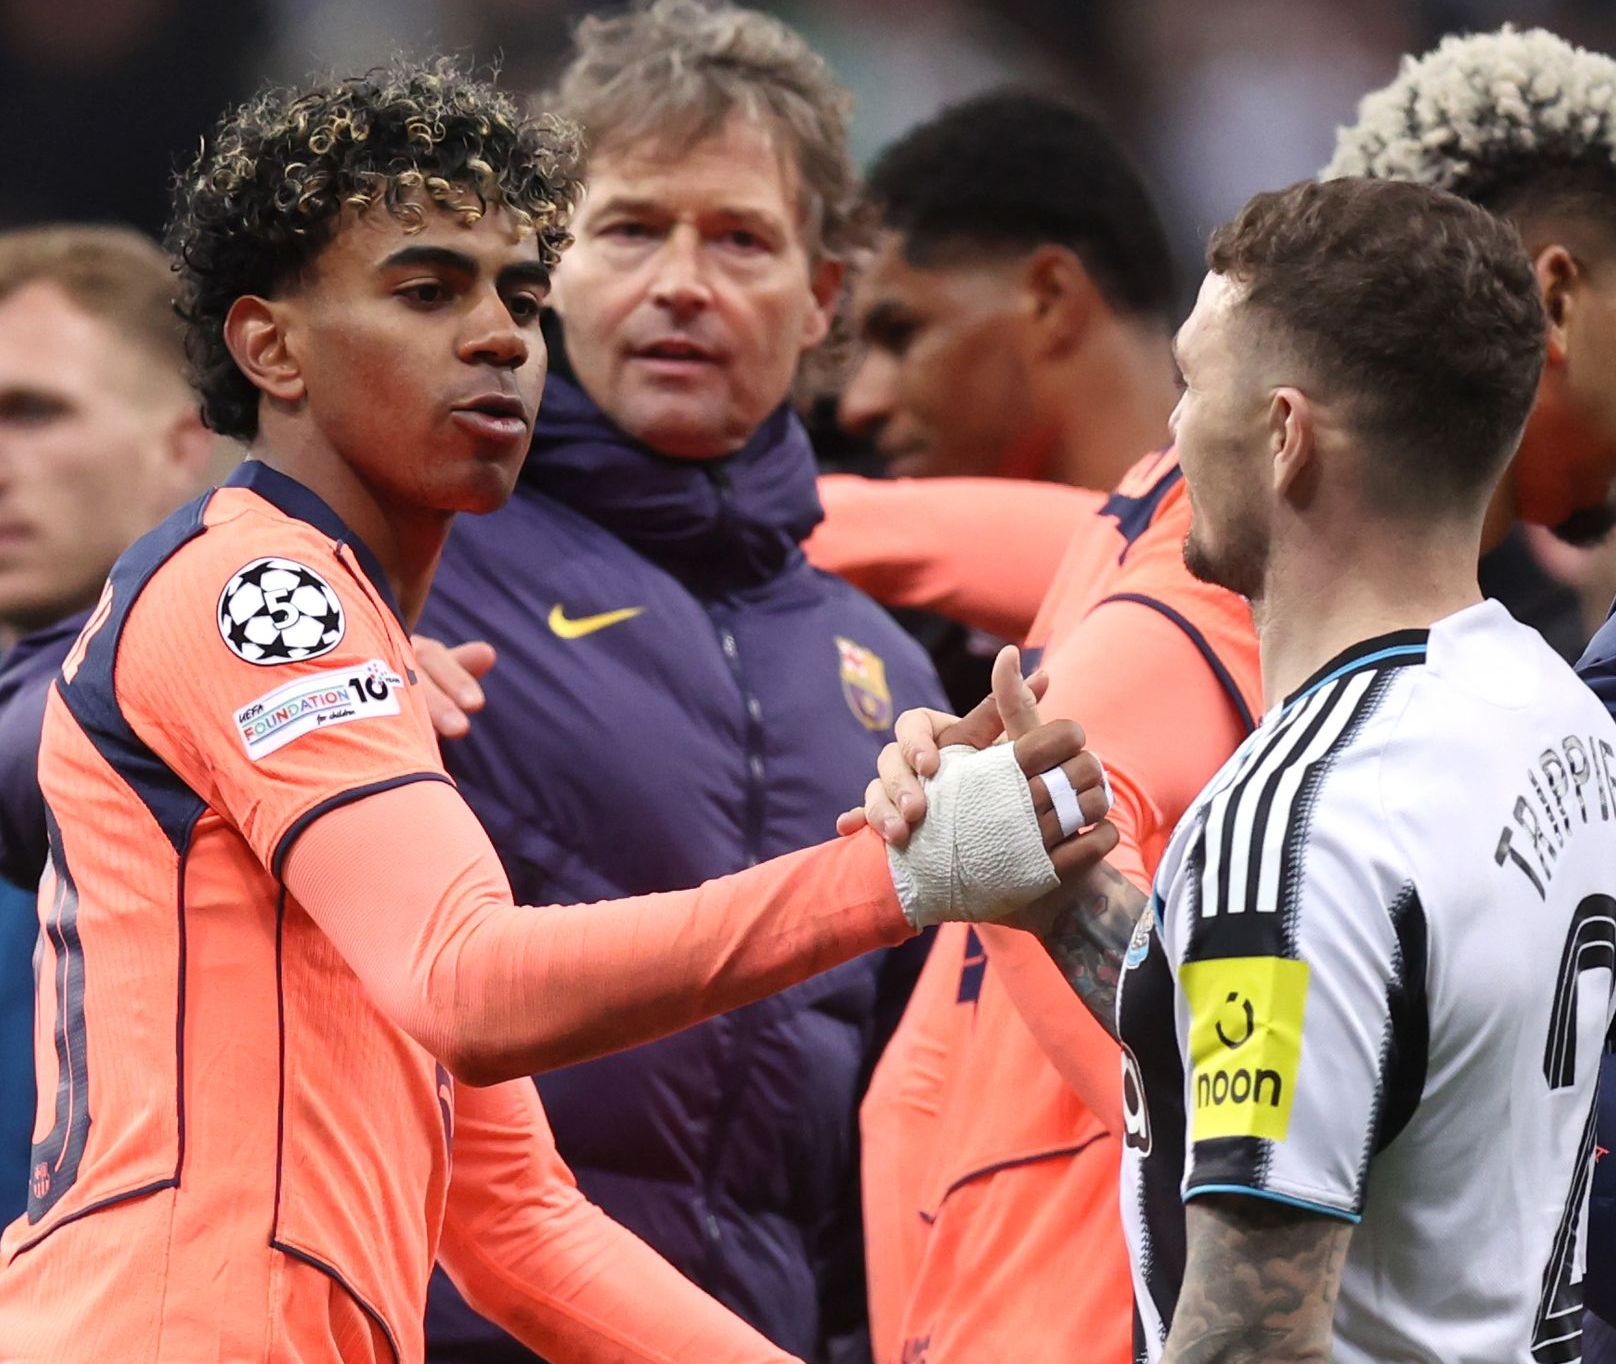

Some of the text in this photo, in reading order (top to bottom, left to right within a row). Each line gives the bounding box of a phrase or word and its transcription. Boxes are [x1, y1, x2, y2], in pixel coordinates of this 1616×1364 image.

[262, 588, 300, 631] 5
[349, 667, 388, 703] 10
[238, 704, 265, 724] UEFA
[243, 689, 351, 742] FOUNDATION
[1197, 1067, 1282, 1110] noon
